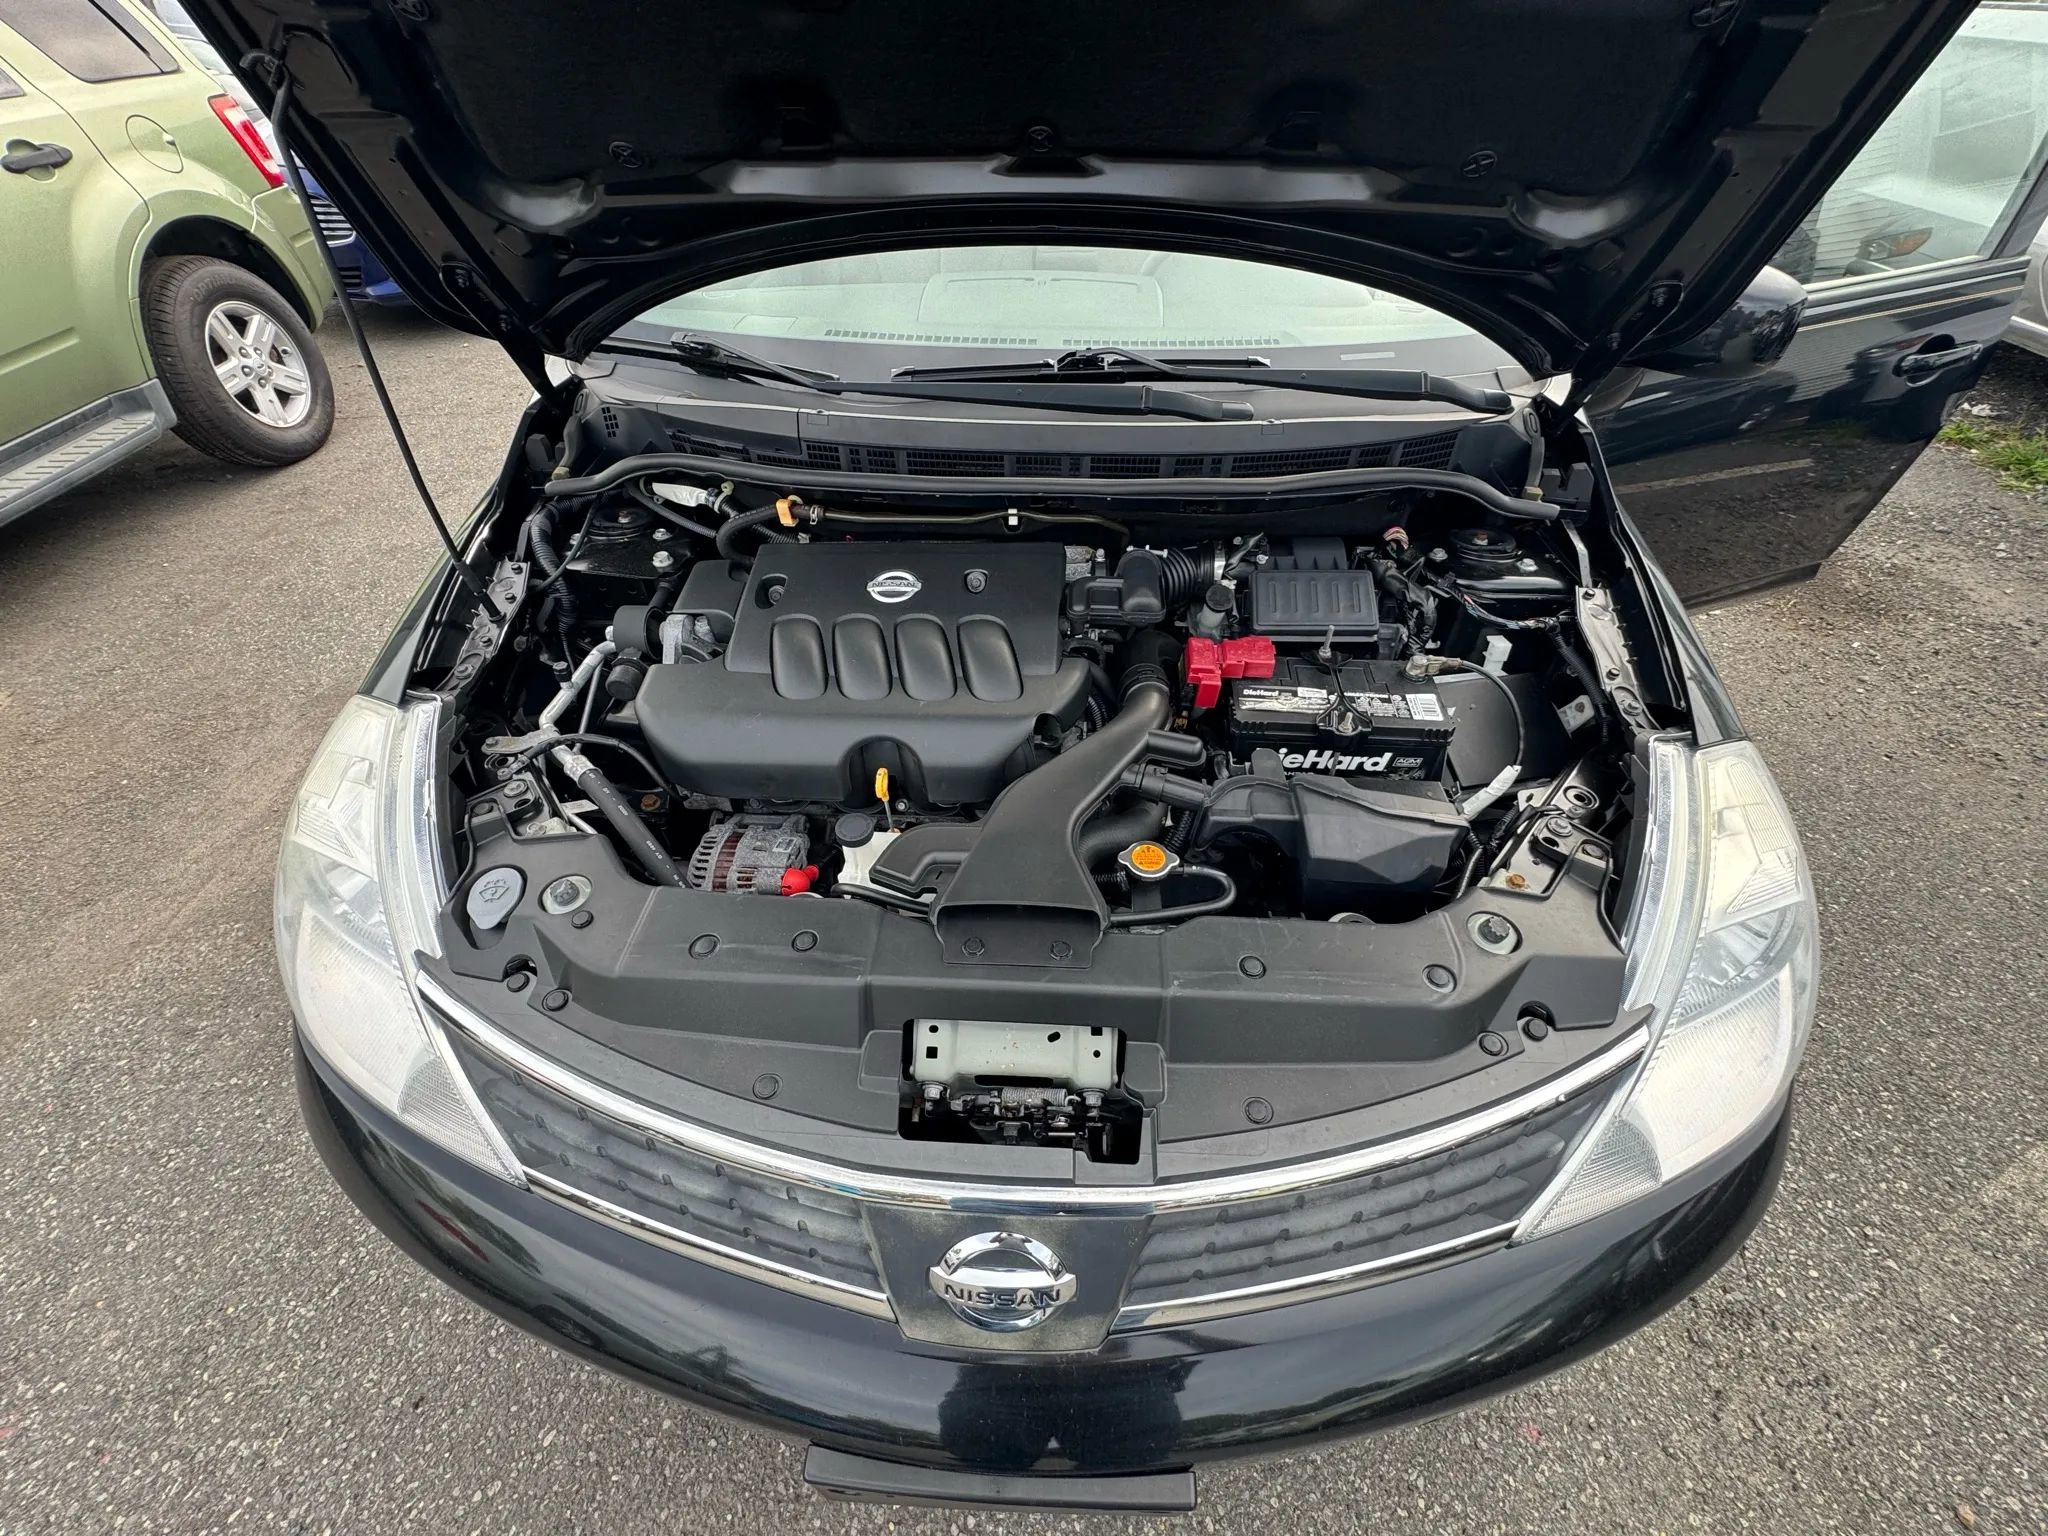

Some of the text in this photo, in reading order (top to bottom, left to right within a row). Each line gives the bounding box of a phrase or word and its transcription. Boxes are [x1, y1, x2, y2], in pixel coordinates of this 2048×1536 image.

[1243, 689, 1279, 697] DieHard
[1257, 747, 1393, 771] ieHard
[944, 1284, 1061, 1309] NISSAN
